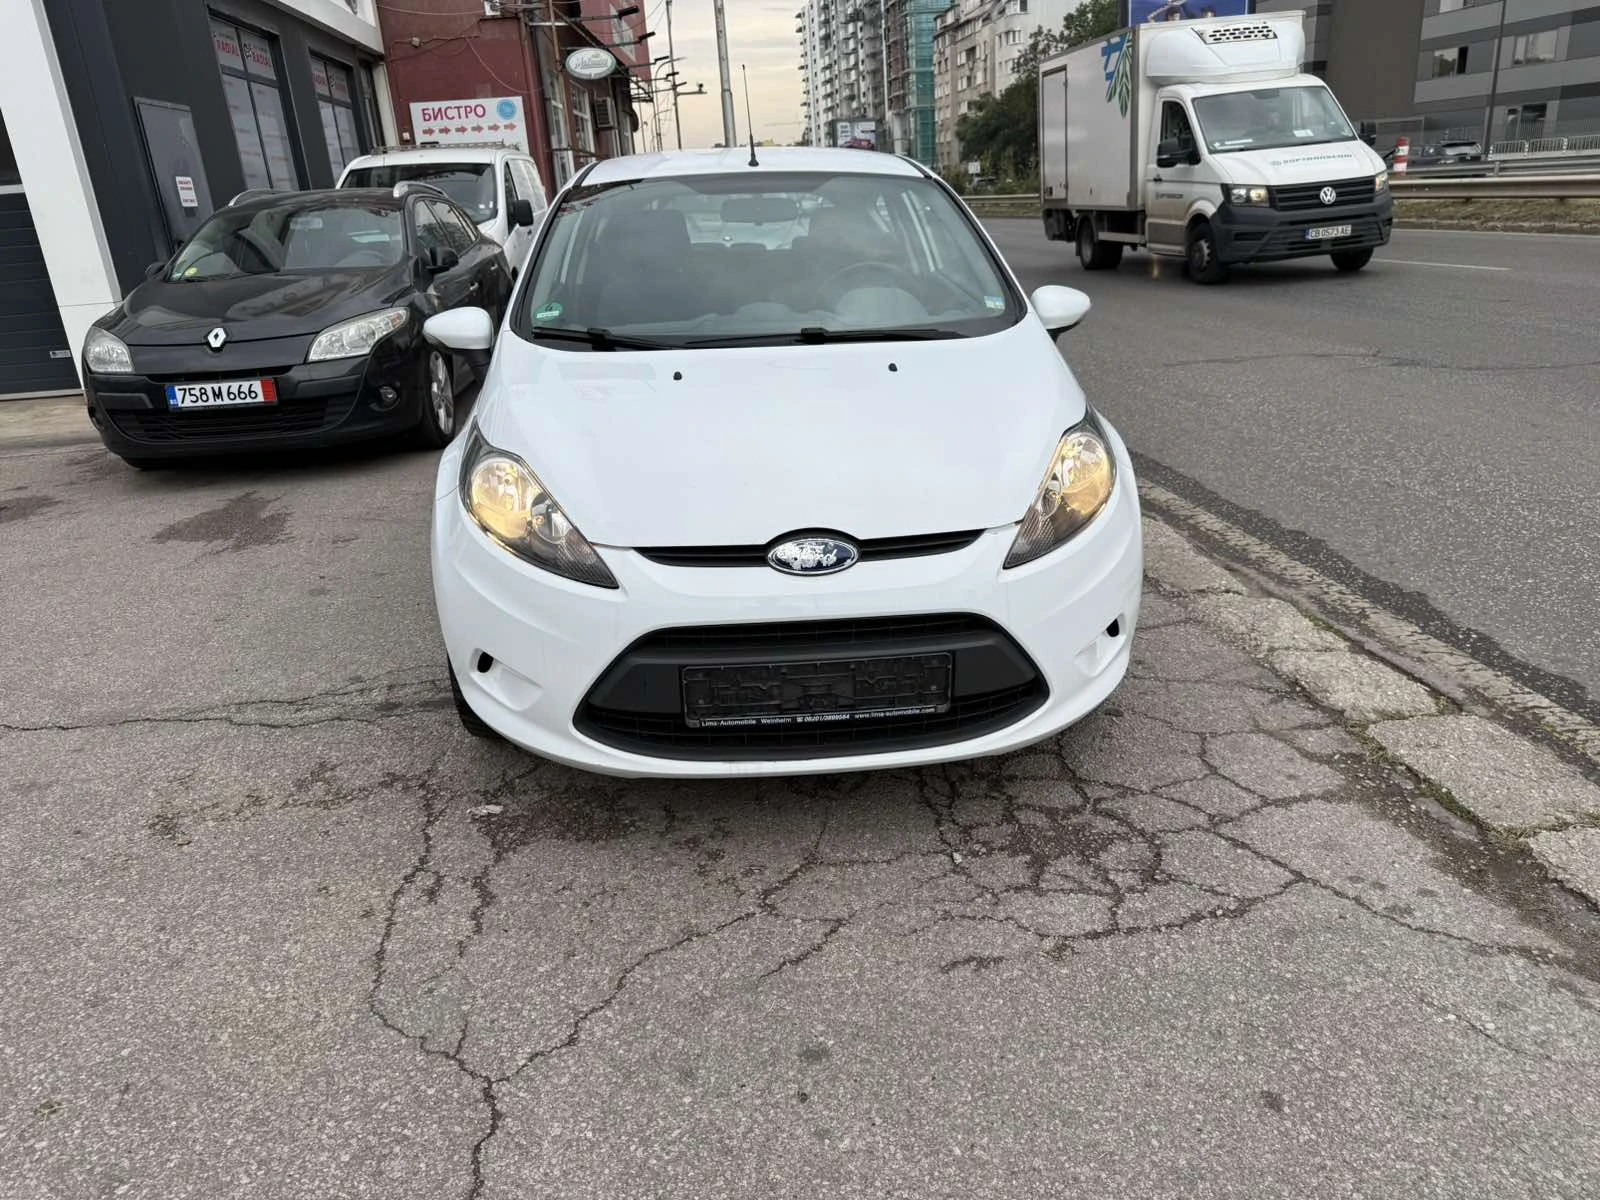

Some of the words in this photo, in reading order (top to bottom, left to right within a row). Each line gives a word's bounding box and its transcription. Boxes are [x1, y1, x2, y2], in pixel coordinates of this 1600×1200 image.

[422, 103, 486, 122] БИСТРО
[178, 387, 209, 404] 758
[211, 386, 225, 402] M
[227, 384, 258, 400] 666
